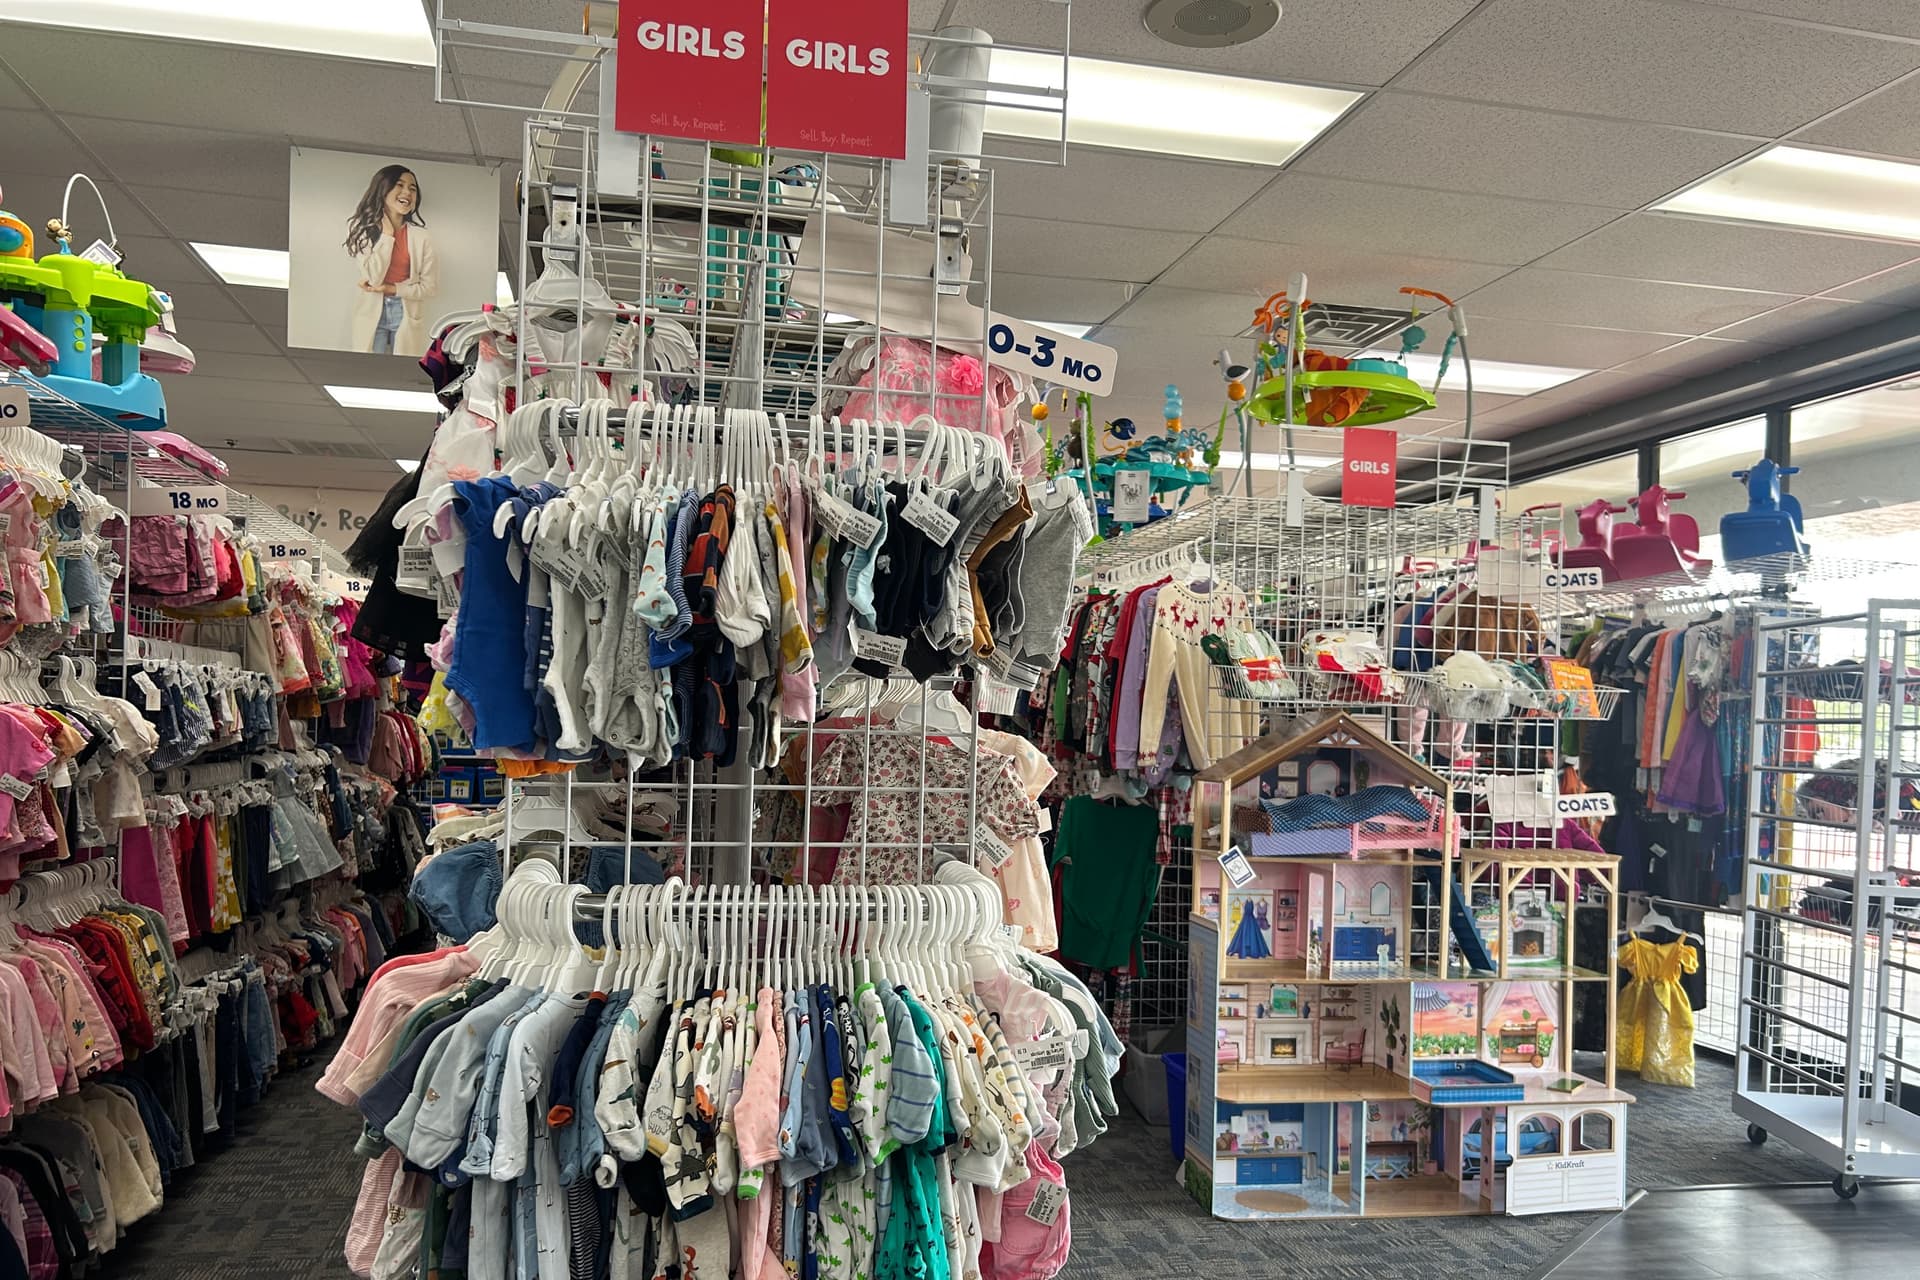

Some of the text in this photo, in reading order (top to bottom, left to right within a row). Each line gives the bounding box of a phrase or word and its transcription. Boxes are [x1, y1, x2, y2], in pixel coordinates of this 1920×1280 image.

[636, 21, 746, 60] GIRLS
[785, 38, 891, 77] GIRLS
[988, 323, 1102, 383] 0-3 MO
[0, 404, 18, 418] O
[1349, 459, 1391, 475] GIRLS
[168, 491, 219, 509] 18 MO
[269, 544, 307, 557] 18 MO
[346, 581, 361, 592] 18
[1546, 573, 1598, 588] COATS
[1557, 798, 1609, 813] COATS
[1555, 1160, 1585, 1169] KidKraft
